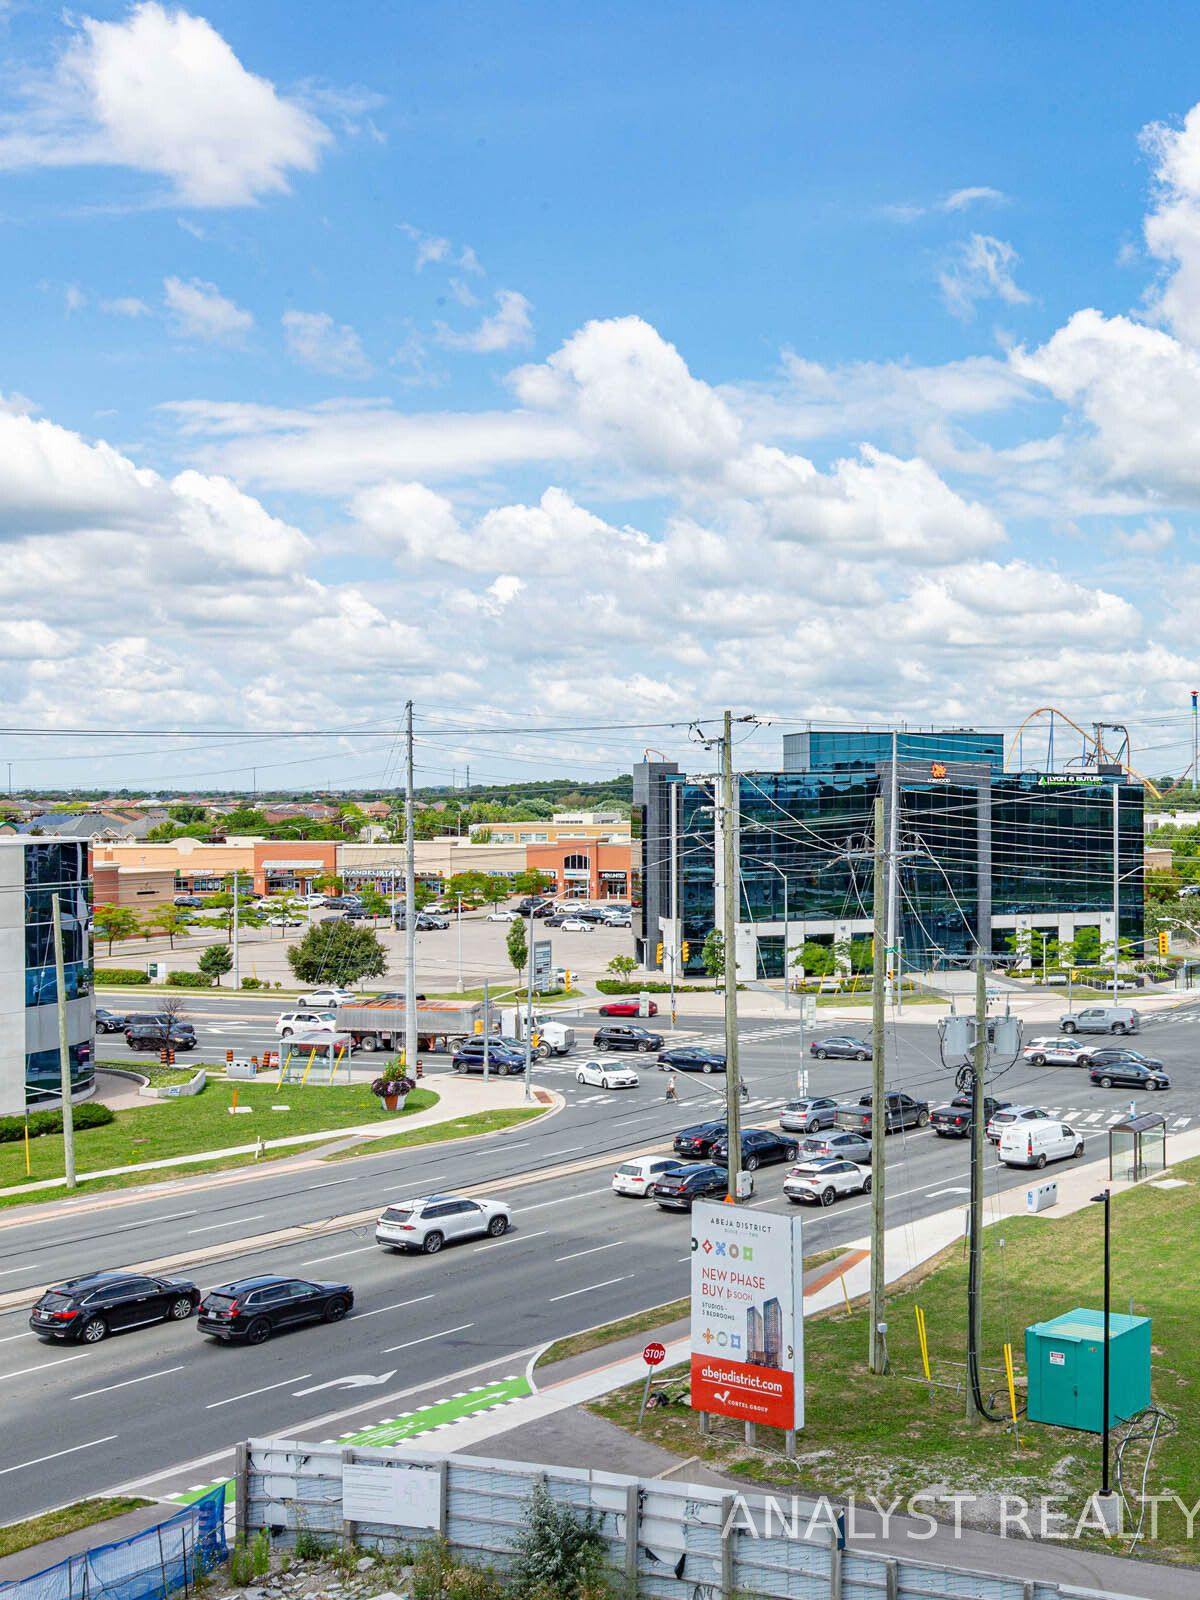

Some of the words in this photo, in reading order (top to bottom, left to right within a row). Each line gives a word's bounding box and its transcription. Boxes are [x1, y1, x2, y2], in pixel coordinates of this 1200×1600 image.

[710, 1217, 734, 1227] ABEJA
[735, 1220, 772, 1233] DISTRICT
[702, 1267, 727, 1281] NEW
[730, 1272, 766, 1290] PHASE
[702, 1283, 724, 1298] BUY
[733, 1290, 753, 1301] SOON
[702, 1302, 724, 1311] STUDIOS
[706, 1310, 735, 1321] BEDROOMS
[644, 1349, 665, 1359] STOP
[701, 1364, 783, 1393] abejadistrict.com
[727, 1399, 749, 1409] CORTEL
[749, 1404, 768, 1413] GROUP
